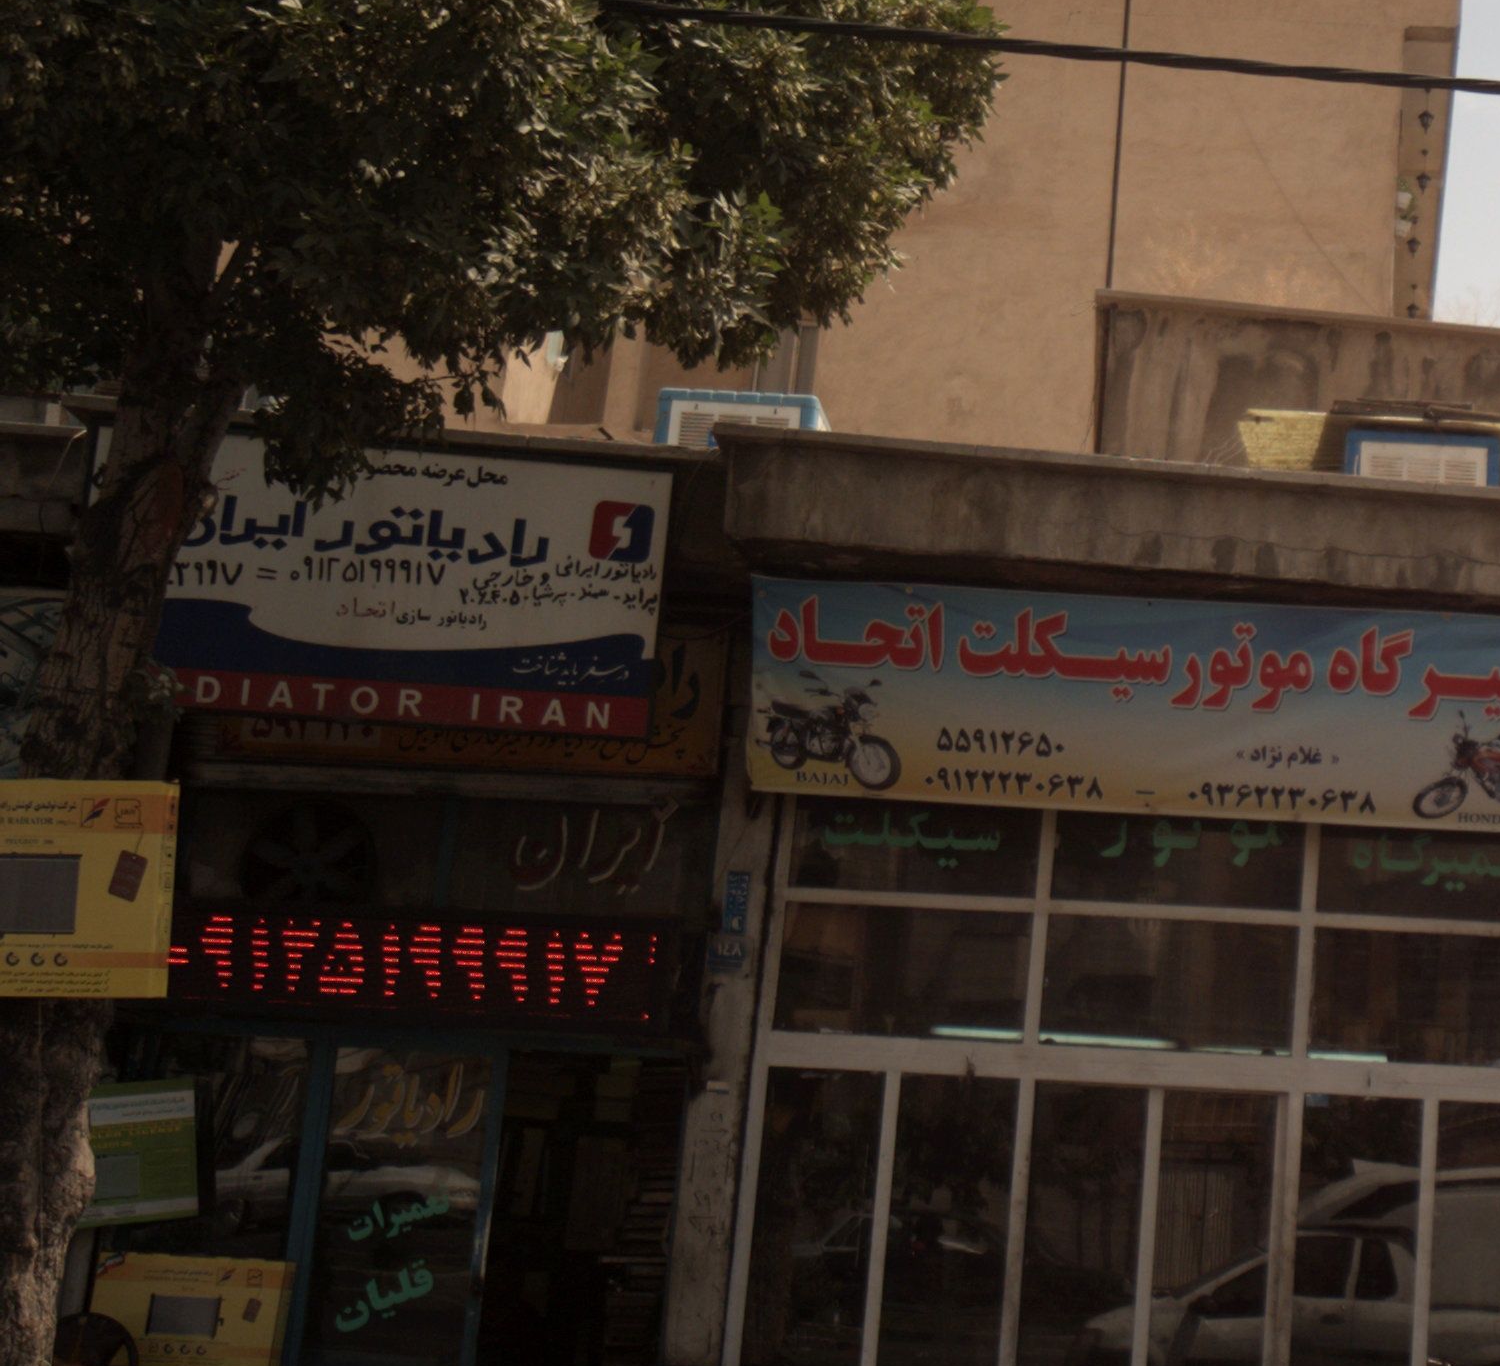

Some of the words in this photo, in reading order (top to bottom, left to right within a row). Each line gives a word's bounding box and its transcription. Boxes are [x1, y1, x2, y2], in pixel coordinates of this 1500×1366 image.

[421, 463, 466, 486] عرضه
[467, 466, 508, 487] محل
[314, 506, 549, 567] رادیاتور
[290, 556, 445, 586] ۰۹۱۲۵۱۹۹۹۱۷
[473, 569, 534, 591] خارجی
[556, 556, 600, 578] ایرانی
[602, 563, 657, 585] رادیاتور
[337, 597, 395, 618] اتحاد
[396, 608, 431, 625] سازی
[437, 610, 487, 630] رادیاتور
[767, 596, 945, 670] اتحاد
[197, 677, 422, 718] DIATOR
[471, 694, 611, 730] IRAN
[937, 727, 1064, 757] ۵۵۹۱۲۶۵۰
[796, 771, 849, 786] BAJAJ
[925, 767, 1103, 800] ۰۹۱۲۲۲۳۰۶۳۸
[1186, 781, 1377, 814] ۰۹۳۶۲۲۳۰۶۳۸
[332, 1064, 485, 1149] رادیاتور
[335, 1258, 434, 1333] قلیان
